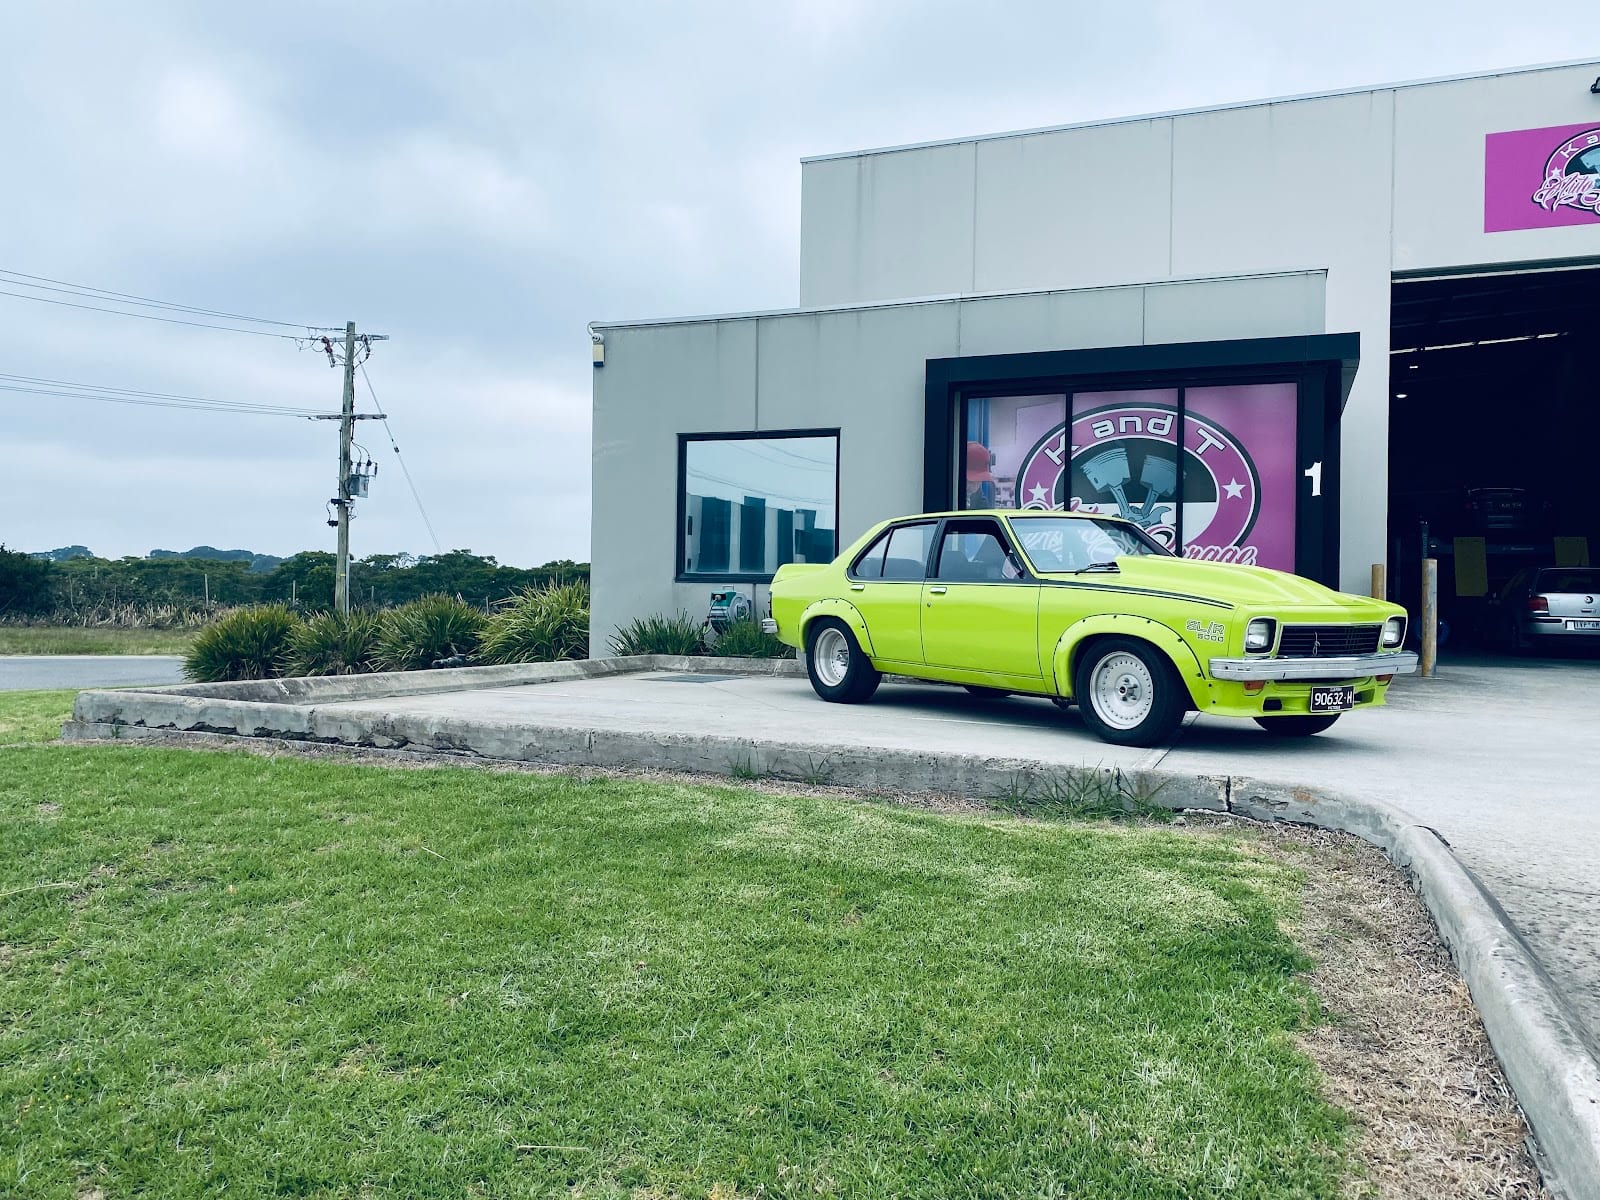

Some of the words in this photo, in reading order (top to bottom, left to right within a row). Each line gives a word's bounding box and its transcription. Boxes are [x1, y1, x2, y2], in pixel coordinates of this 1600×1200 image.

[1559, 142, 1580, 158] K
[1043, 433, 1081, 466] K
[1091, 414, 1174, 439] and
[1196, 428, 1226, 455] T
[1304, 460, 1322, 497] 1
